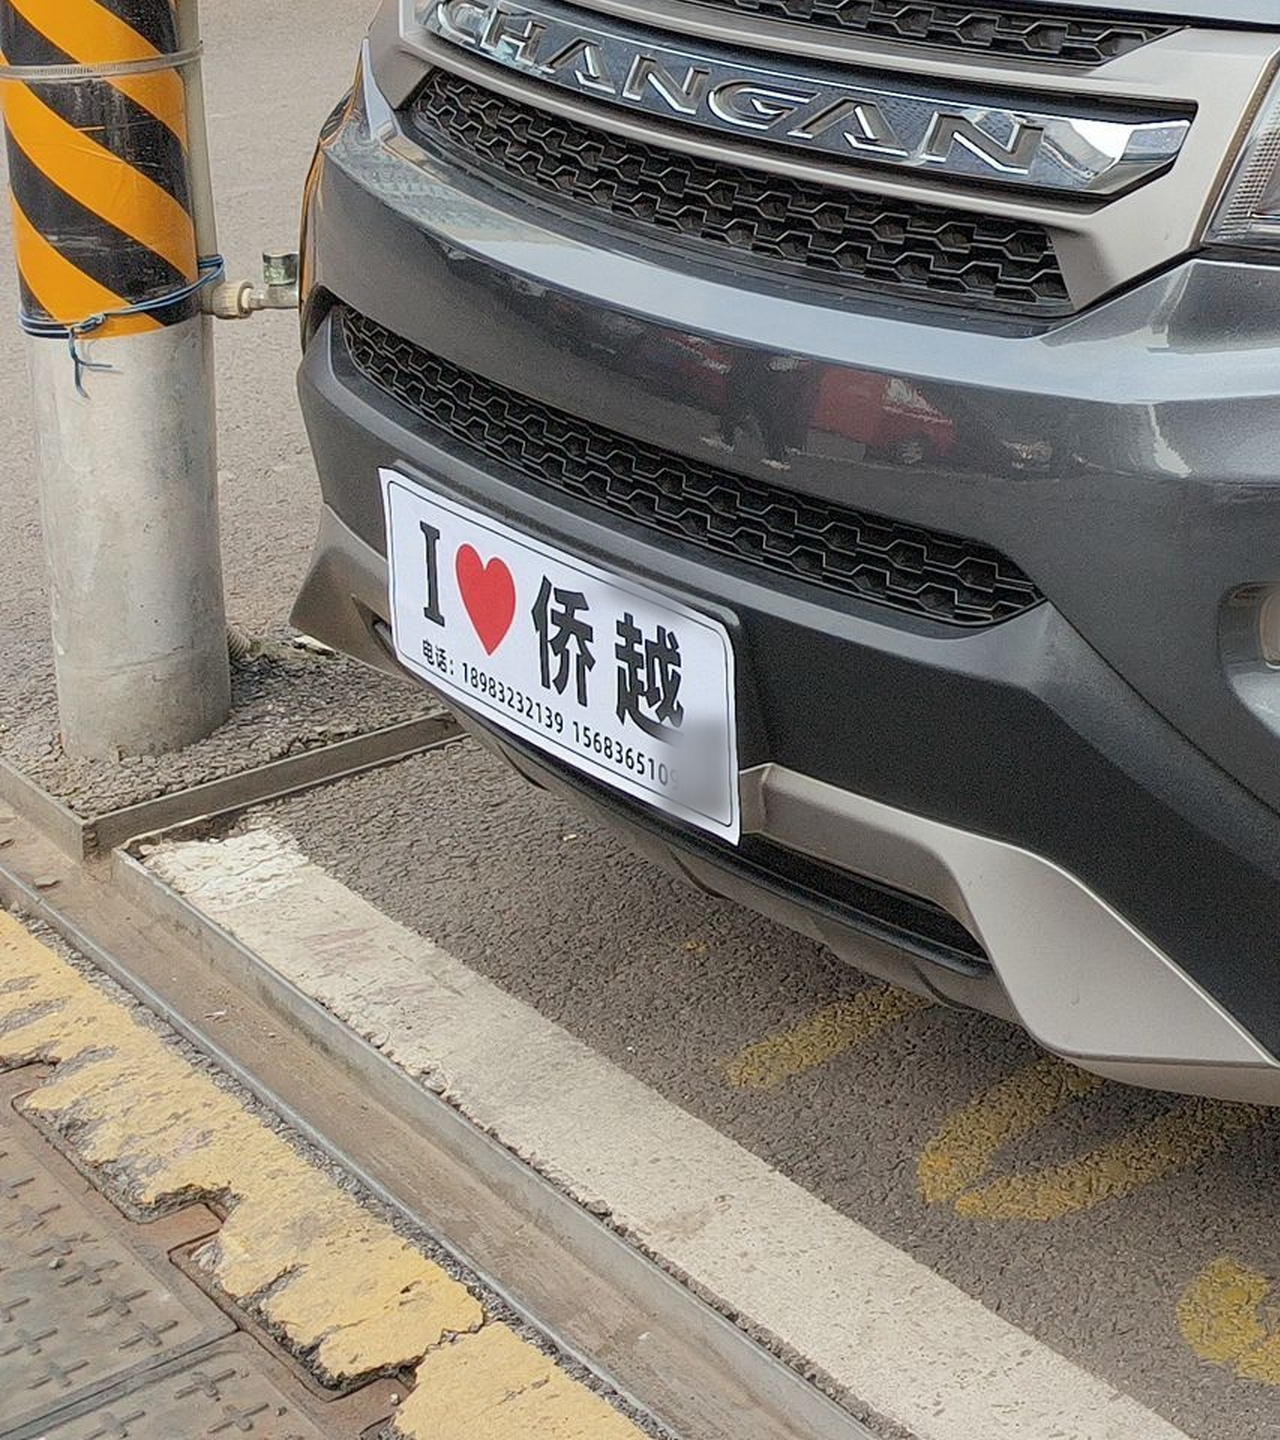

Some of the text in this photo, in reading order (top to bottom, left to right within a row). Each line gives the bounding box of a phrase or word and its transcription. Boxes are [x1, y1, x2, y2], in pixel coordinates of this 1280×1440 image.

[419, 520, 685, 746] I 侨越
[461, 661, 565, 734] 18983232139
